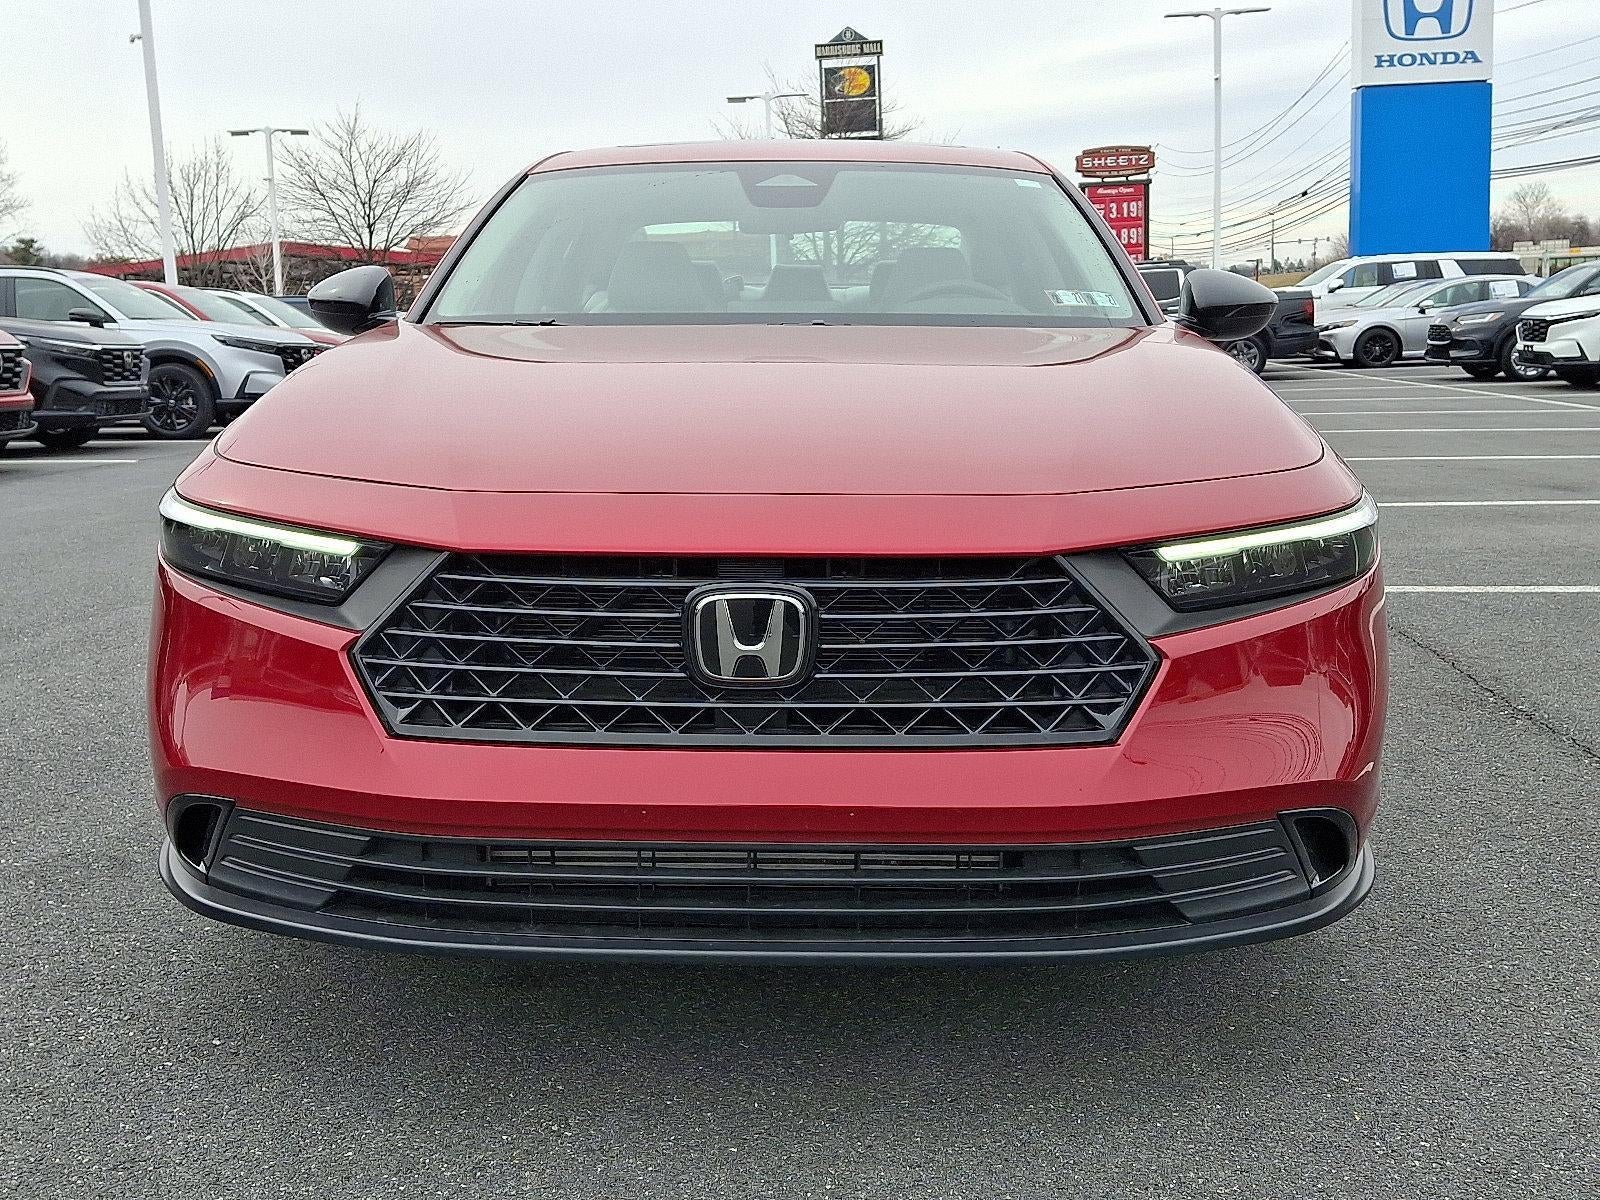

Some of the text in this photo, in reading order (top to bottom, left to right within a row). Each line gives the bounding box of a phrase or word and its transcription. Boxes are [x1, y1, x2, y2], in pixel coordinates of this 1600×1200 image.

[1374, 50, 1482, 68] HONDA
[1082, 155, 1149, 168] SHEETZ
[1119, 186, 1135, 194] Open
